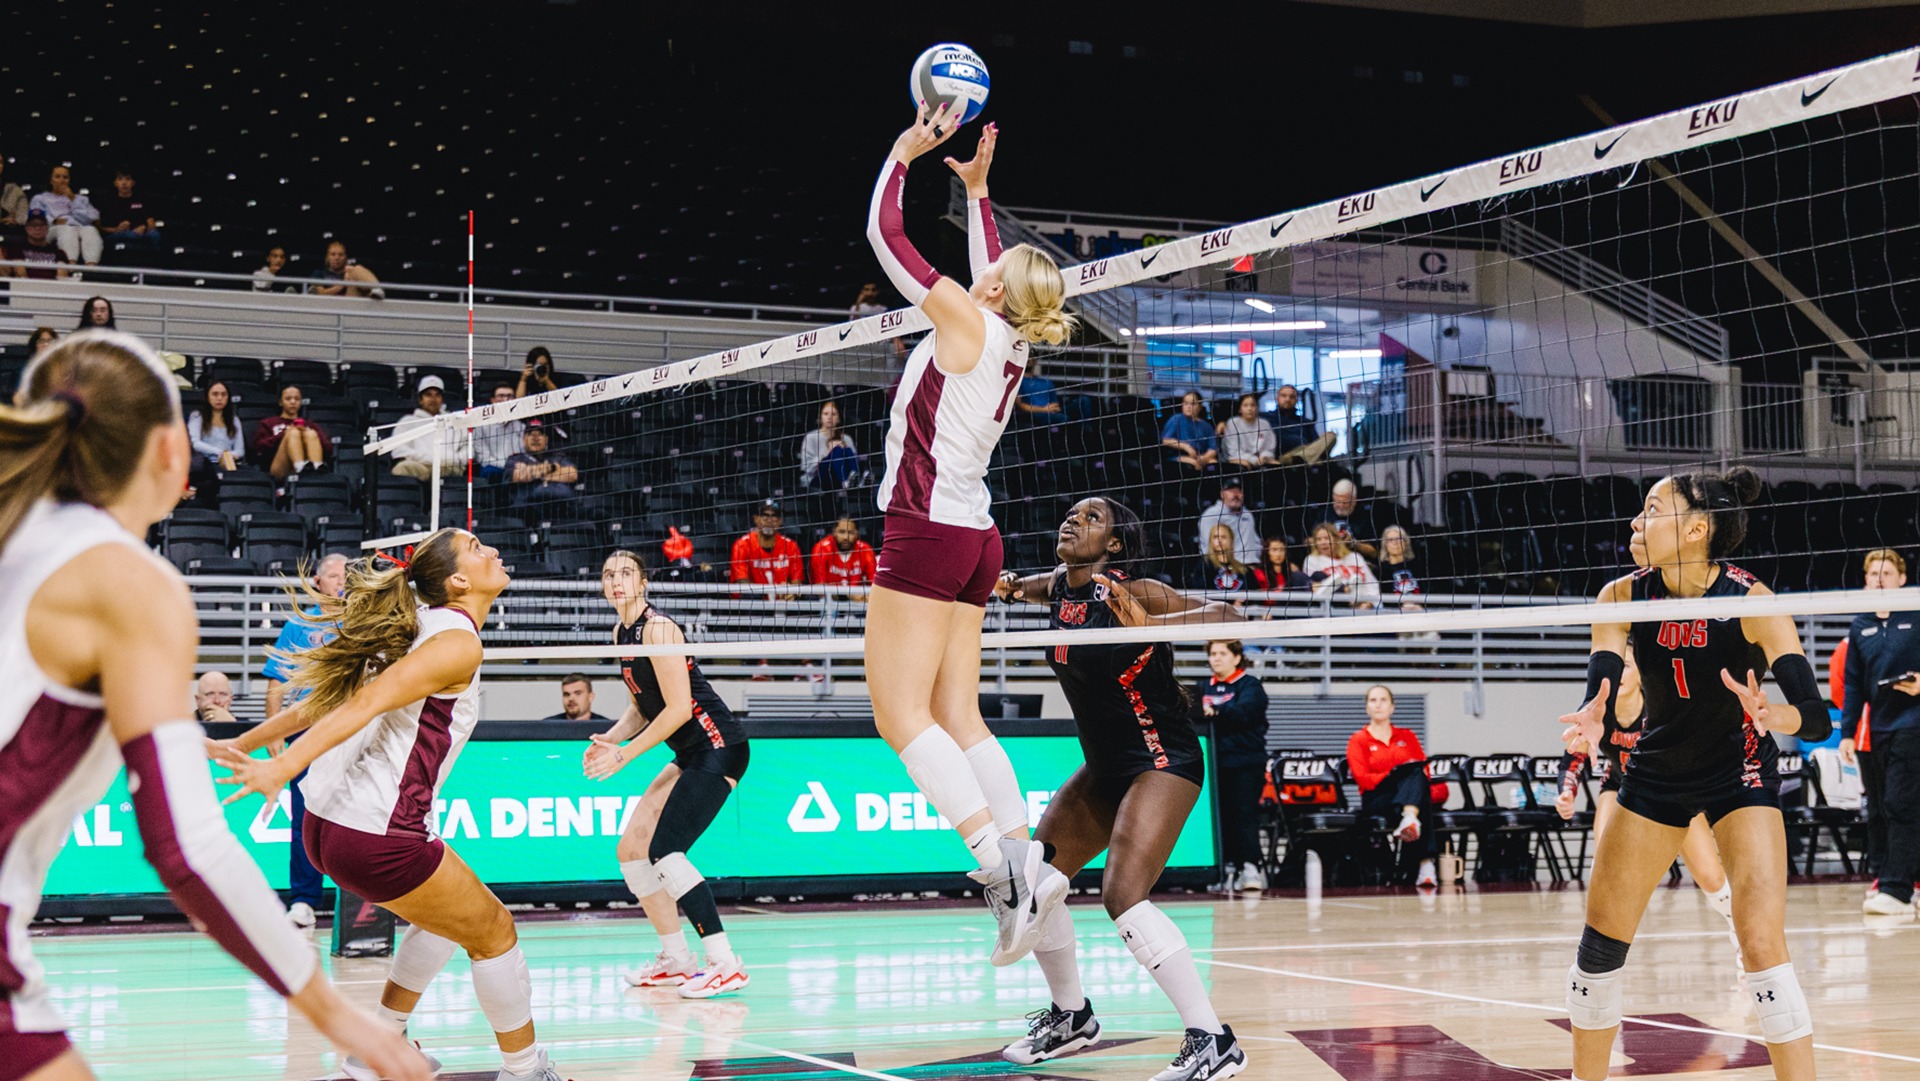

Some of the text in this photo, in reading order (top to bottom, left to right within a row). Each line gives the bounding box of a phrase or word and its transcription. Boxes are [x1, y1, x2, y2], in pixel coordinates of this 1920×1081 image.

[944, 53, 985, 69] molten
[1690, 98, 1740, 131] EKU
[1500, 151, 1542, 179] EKU
[1338, 192, 1376, 217] EKU
[1201, 229, 1233, 251] EKU
[1081, 259, 1108, 280] EKU
[1397, 278, 1438, 292] Central
[1441, 280, 1469, 293] Bank
[880, 310, 903, 328] EKU
[797, 331, 817, 348] EKU
[721, 349, 740, 364] EKU
[653, 365, 669, 380] EKU
[591, 381, 606, 394] EKU
[994, 360, 1024, 424] 7
[1671, 658, 1691, 699] 1
[1283, 760, 1326, 777] EKU
[1474, 759, 1513, 776] EKU
[1536, 759, 1559, 775] EK
[1777, 756, 1803, 772] KU
[490, 796, 643, 839] DENT
